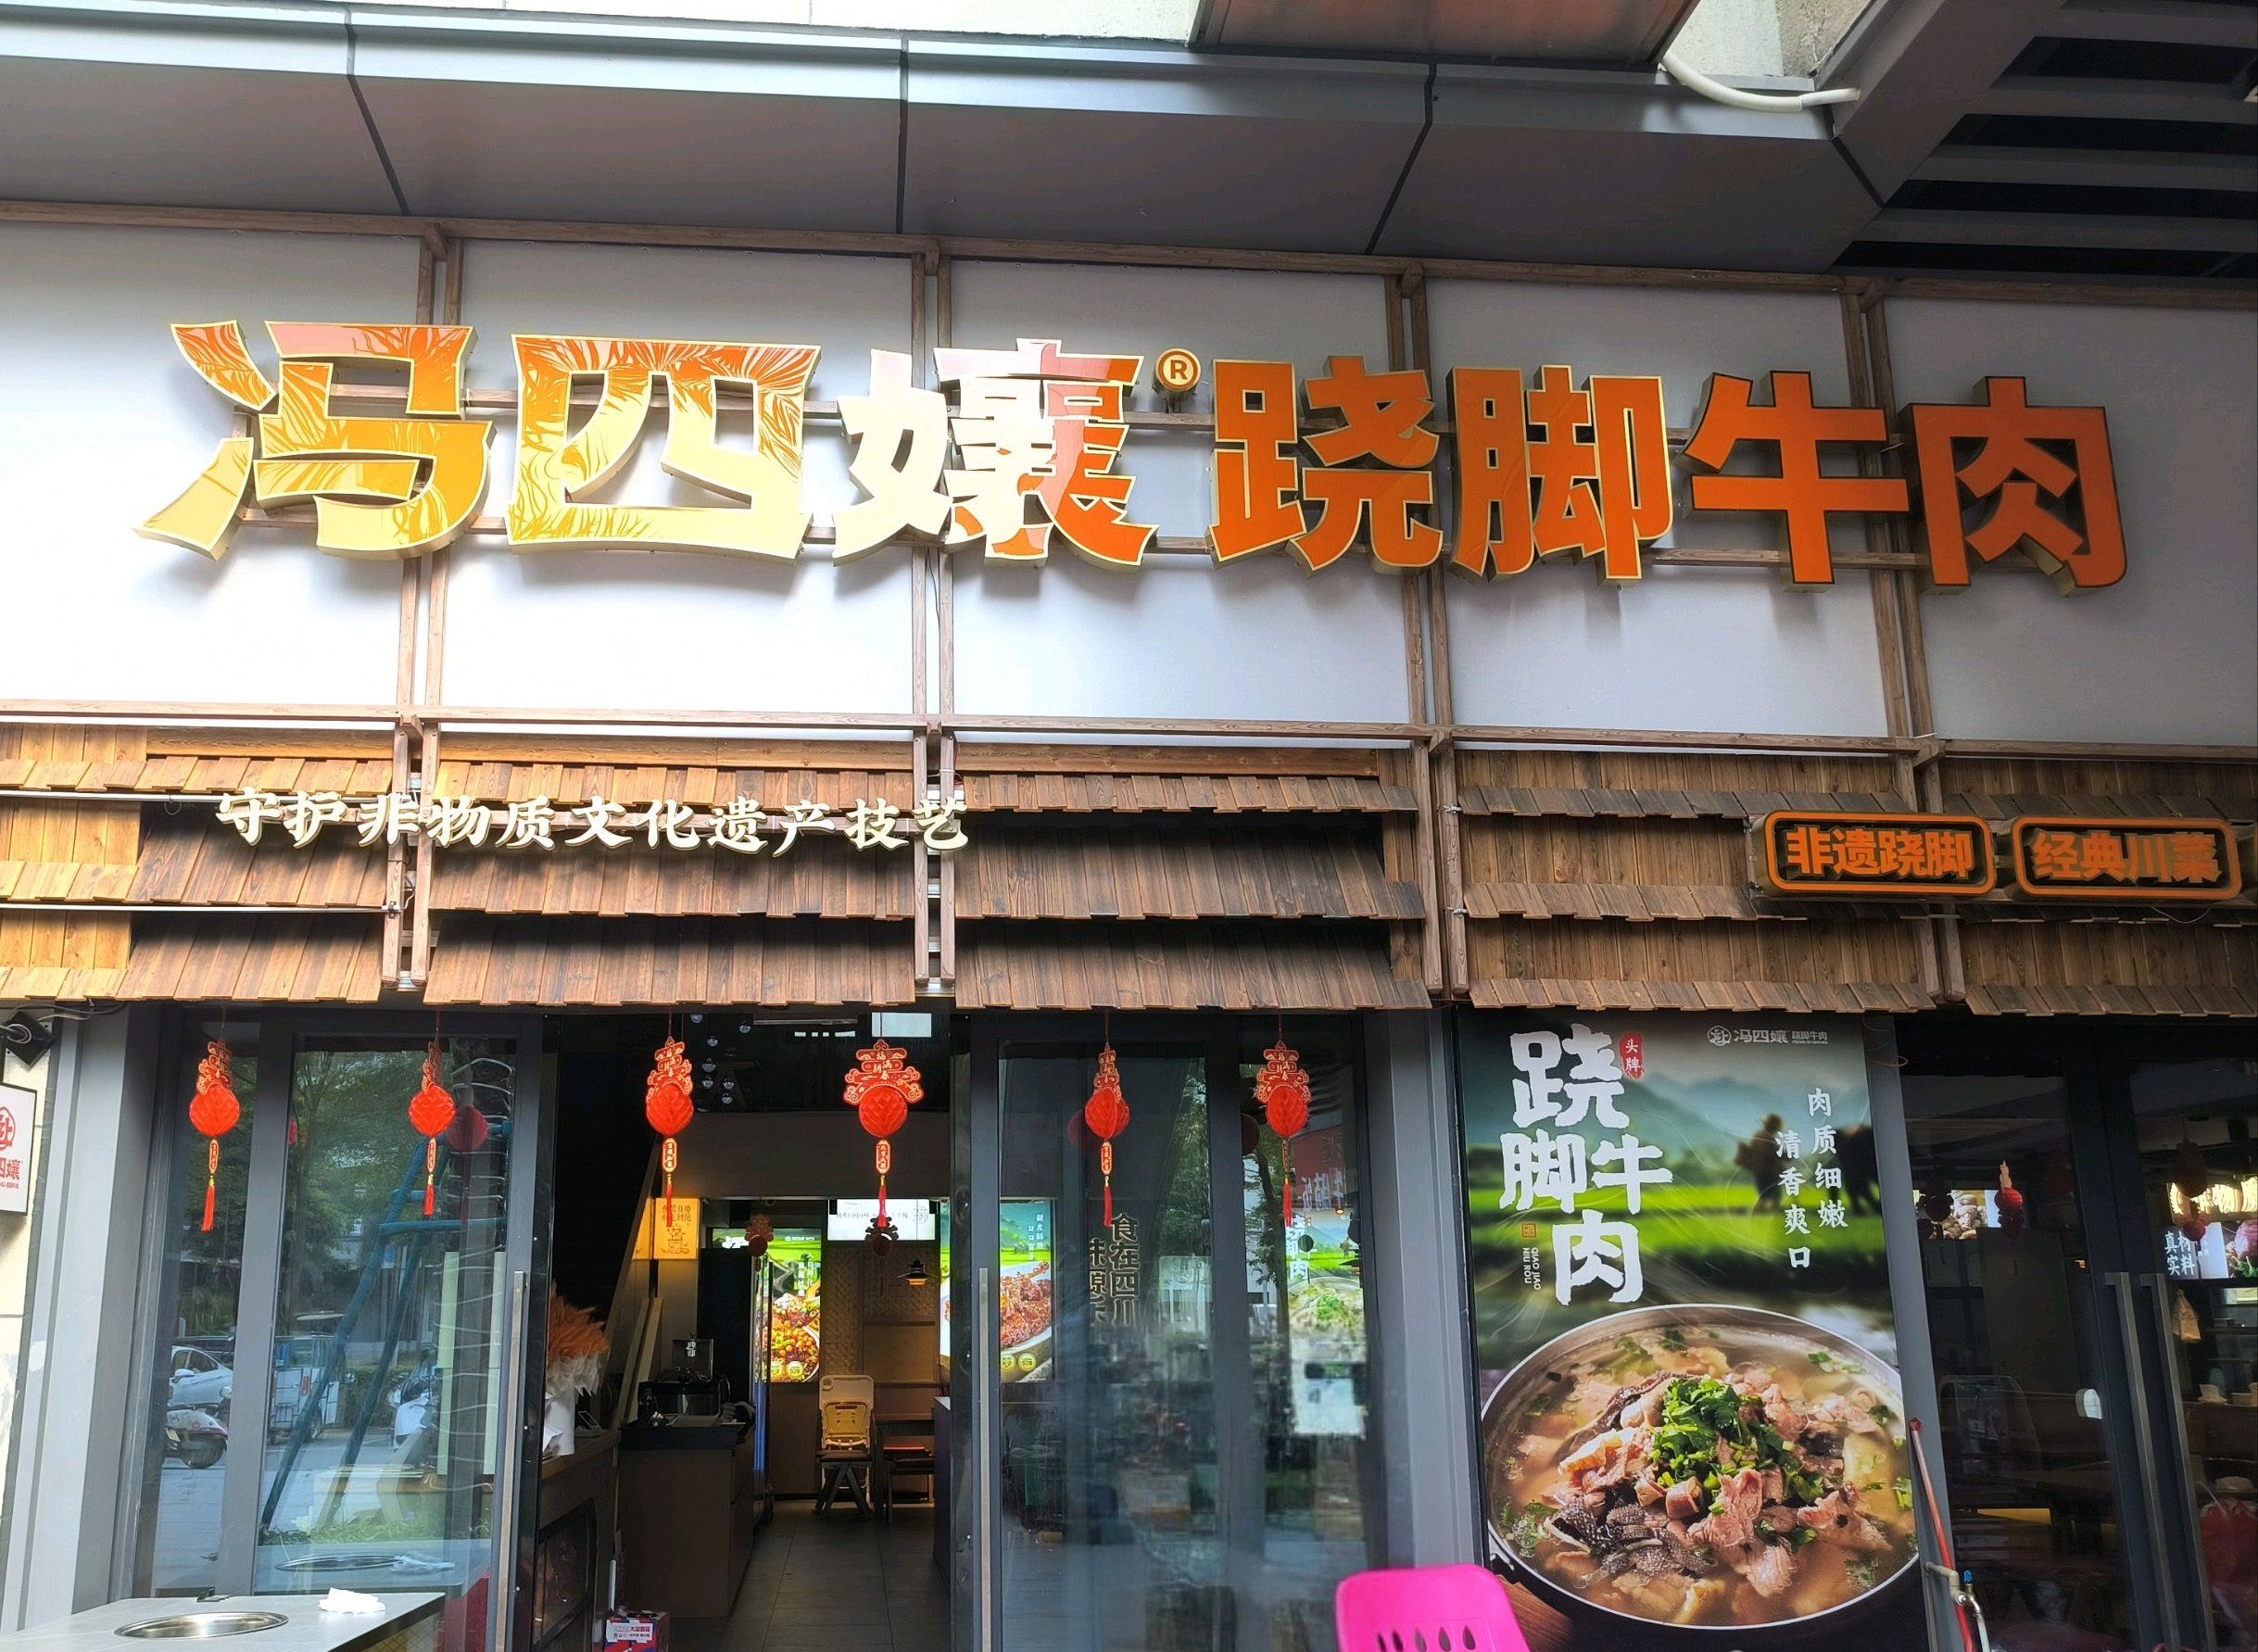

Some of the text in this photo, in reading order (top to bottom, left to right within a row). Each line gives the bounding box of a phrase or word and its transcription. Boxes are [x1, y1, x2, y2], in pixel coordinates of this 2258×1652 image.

[1211, 356, 2127, 588] 跷脚牛肉
[216, 788, 969, 857] 守护非物质文化遗产技艺
[1786, 827, 1974, 878] 非遗跷脚
[2032, 830, 2223, 884] 经典川菜
[1625, 1038, 1641, 1073] 头牌
[1807, 1087, 1848, 1230] 肉质细嫩
[1775, 1130, 1811, 1268] 清香爽口
[1109, 1213, 1141, 1327] 食在四川
[1522, 1247, 1531, 1263] NIU
[1523, 1265, 1532, 1283] ROU
[1531, 1247, 1541, 1291] QIAO JIAO
